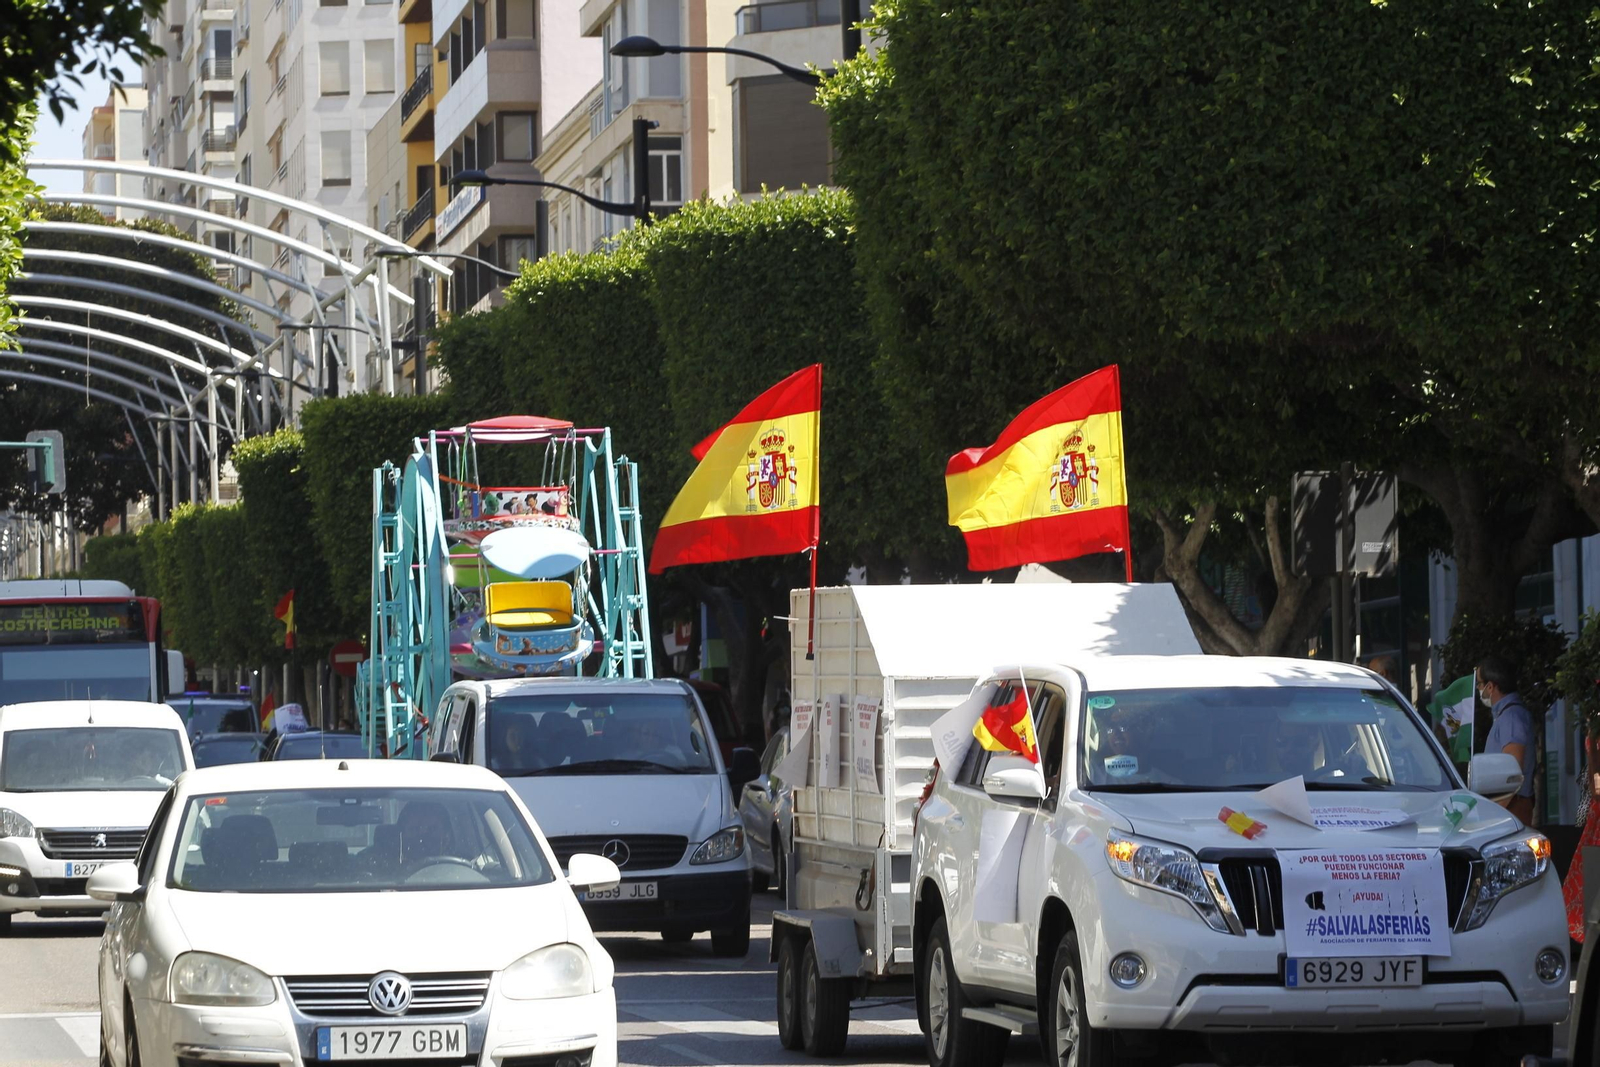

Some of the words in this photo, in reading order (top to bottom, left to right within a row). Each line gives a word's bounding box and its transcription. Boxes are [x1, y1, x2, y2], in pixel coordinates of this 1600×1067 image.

[21, 606, 90, 619] CENTRO
[1299, 855, 1319, 864] ¿POR
[1321, 854, 1338, 863] QUÉ
[1339, 854, 1366, 862] TODOS
[1368, 853, 1384, 861] LOS
[1385, 853, 1427, 861] SECTORES
[74, 863, 104, 876] 827
[1324, 863, 1356, 871] PUEDEN
[1358, 862, 1405, 870] FUNCIONAR
[1331, 872, 1360, 880] MENOS
[1361, 872, 1372, 880] LA
[1374, 871, 1401, 880] FERIA?
[630, 884, 655, 898] JLG
[1352, 892, 1384, 903] ¡AYUDA!
[1305, 913, 1431, 937] #SALVALASFERIAS
[1303, 960, 1364, 983] 6929
[1373, 959, 1417, 983] JYF
[340, 1031, 402, 1055] 1977
[412, 1029, 460, 1053] GBM
